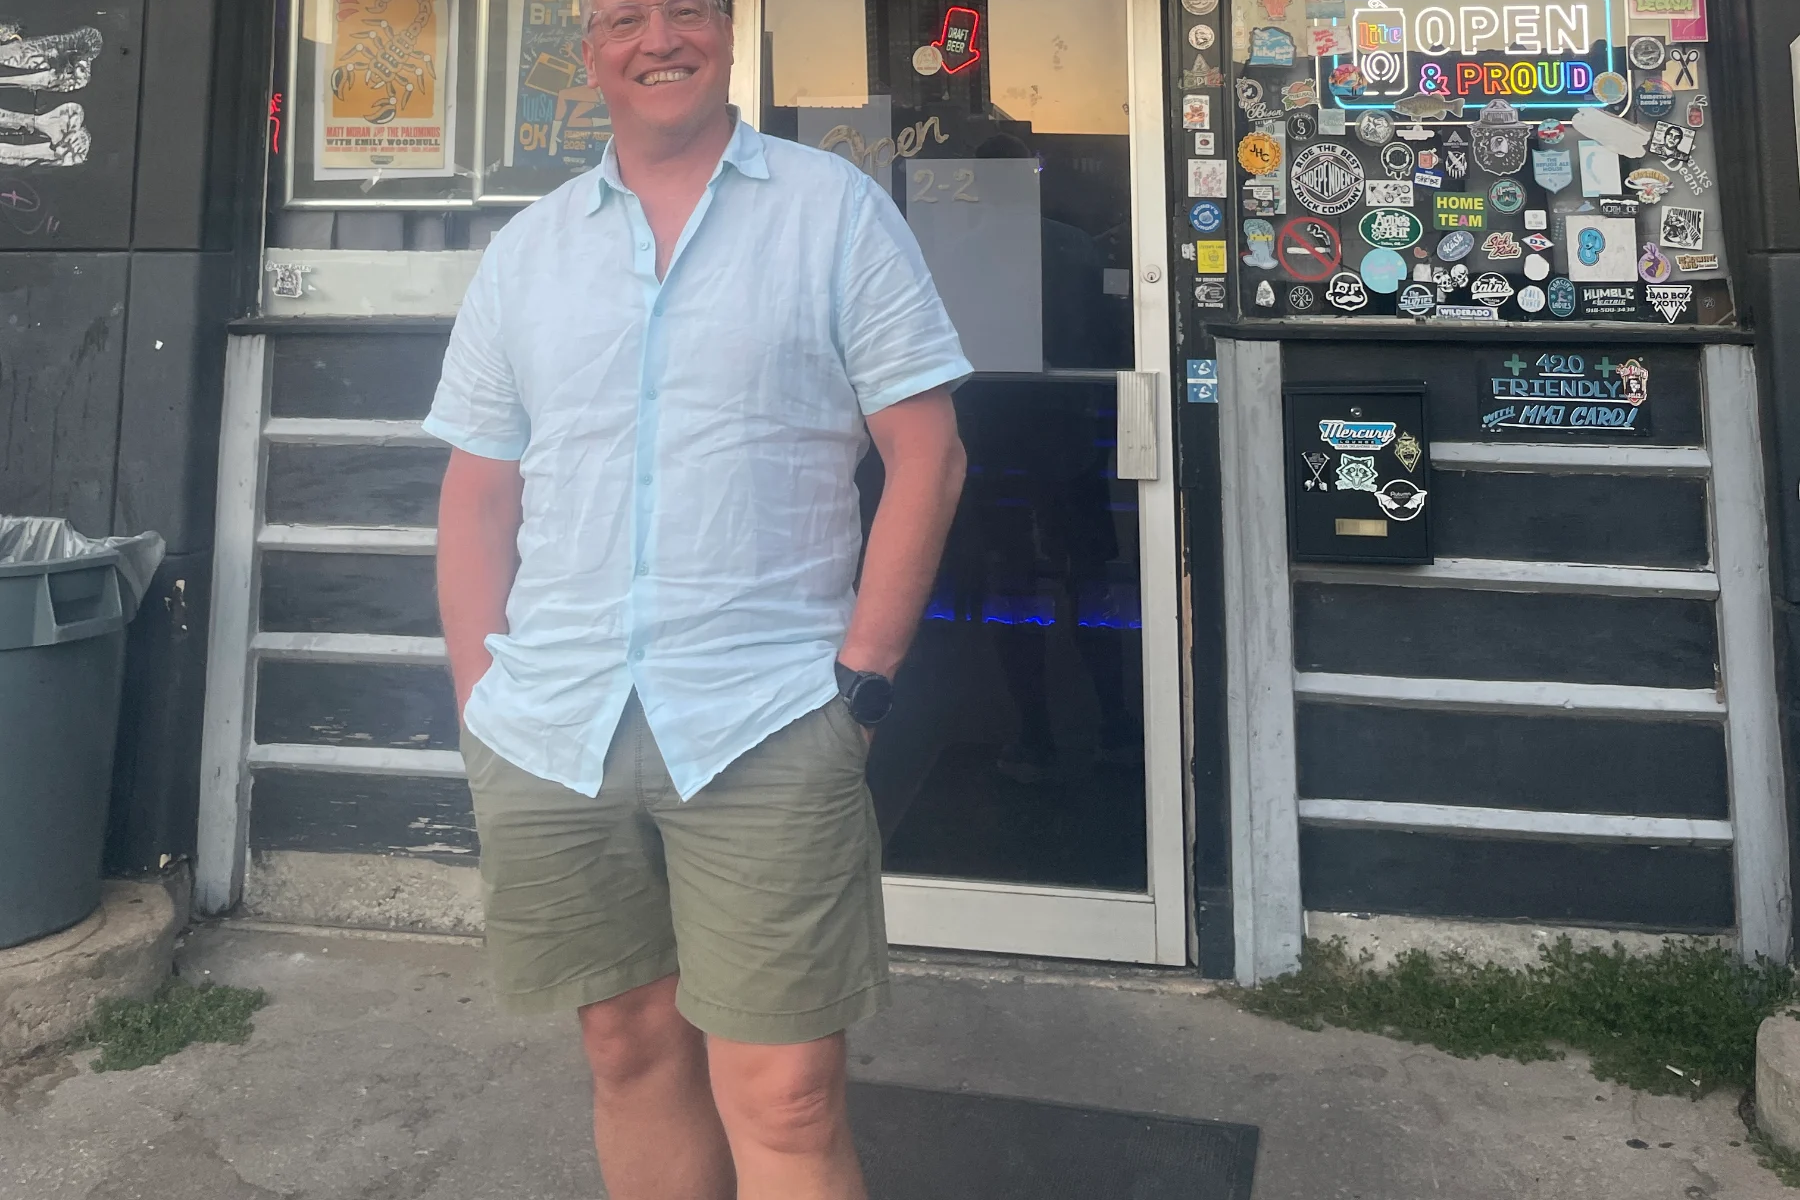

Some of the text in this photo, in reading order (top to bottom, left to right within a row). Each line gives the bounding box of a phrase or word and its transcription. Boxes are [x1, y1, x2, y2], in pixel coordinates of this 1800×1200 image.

[947, 26, 969, 41] DRAFT
[1358, 21, 1401, 51] Lite
[1414, 4, 1591, 56] OPEN
[946, 39, 965, 53] BEER
[1419, 60, 1594, 97] & PROUD
[521, 93, 553, 122] TULSA
[1247, 102, 1283, 118] Bison
[1659, 99, 1672, 107] you
[326, 126, 344, 138] MATT
[387, 126, 399, 138] THE
[519, 122, 548, 151] OK
[326, 138, 441, 146] WITH EMILY WOODHULL
[1249, 144, 1270, 163] JHC
[1295, 144, 1361, 170] RIDE THE BEST
[1299, 159, 1356, 197] INDEPENDENT
[1294, 185, 1320, 212] TRUCK
[1321, 187, 1362, 214] COMPANY
[1436, 196, 1484, 210] HOME
[1602, 205, 1620, 213] NORTH
[1438, 213, 1482, 228] TEAM
[1529, 238, 1547, 247] DX
[1409, 290, 1419, 298] The
[1471, 280, 1514, 294] Cain's
[1583, 287, 1635, 301] HUMBLE
[1649, 291, 1690, 300] BAD BOY
[1655, 299, 1684, 308] XOTIX
[1440, 308, 1490, 317] WILDERADO
[1535, 353, 1585, 374] 420
[1491, 377, 1622, 398] FRIENDLY
[1518, 405, 1566, 425] MMJ
[1569, 406, 1639, 428] CARD!
[1320, 421, 1395, 443] Mercury
